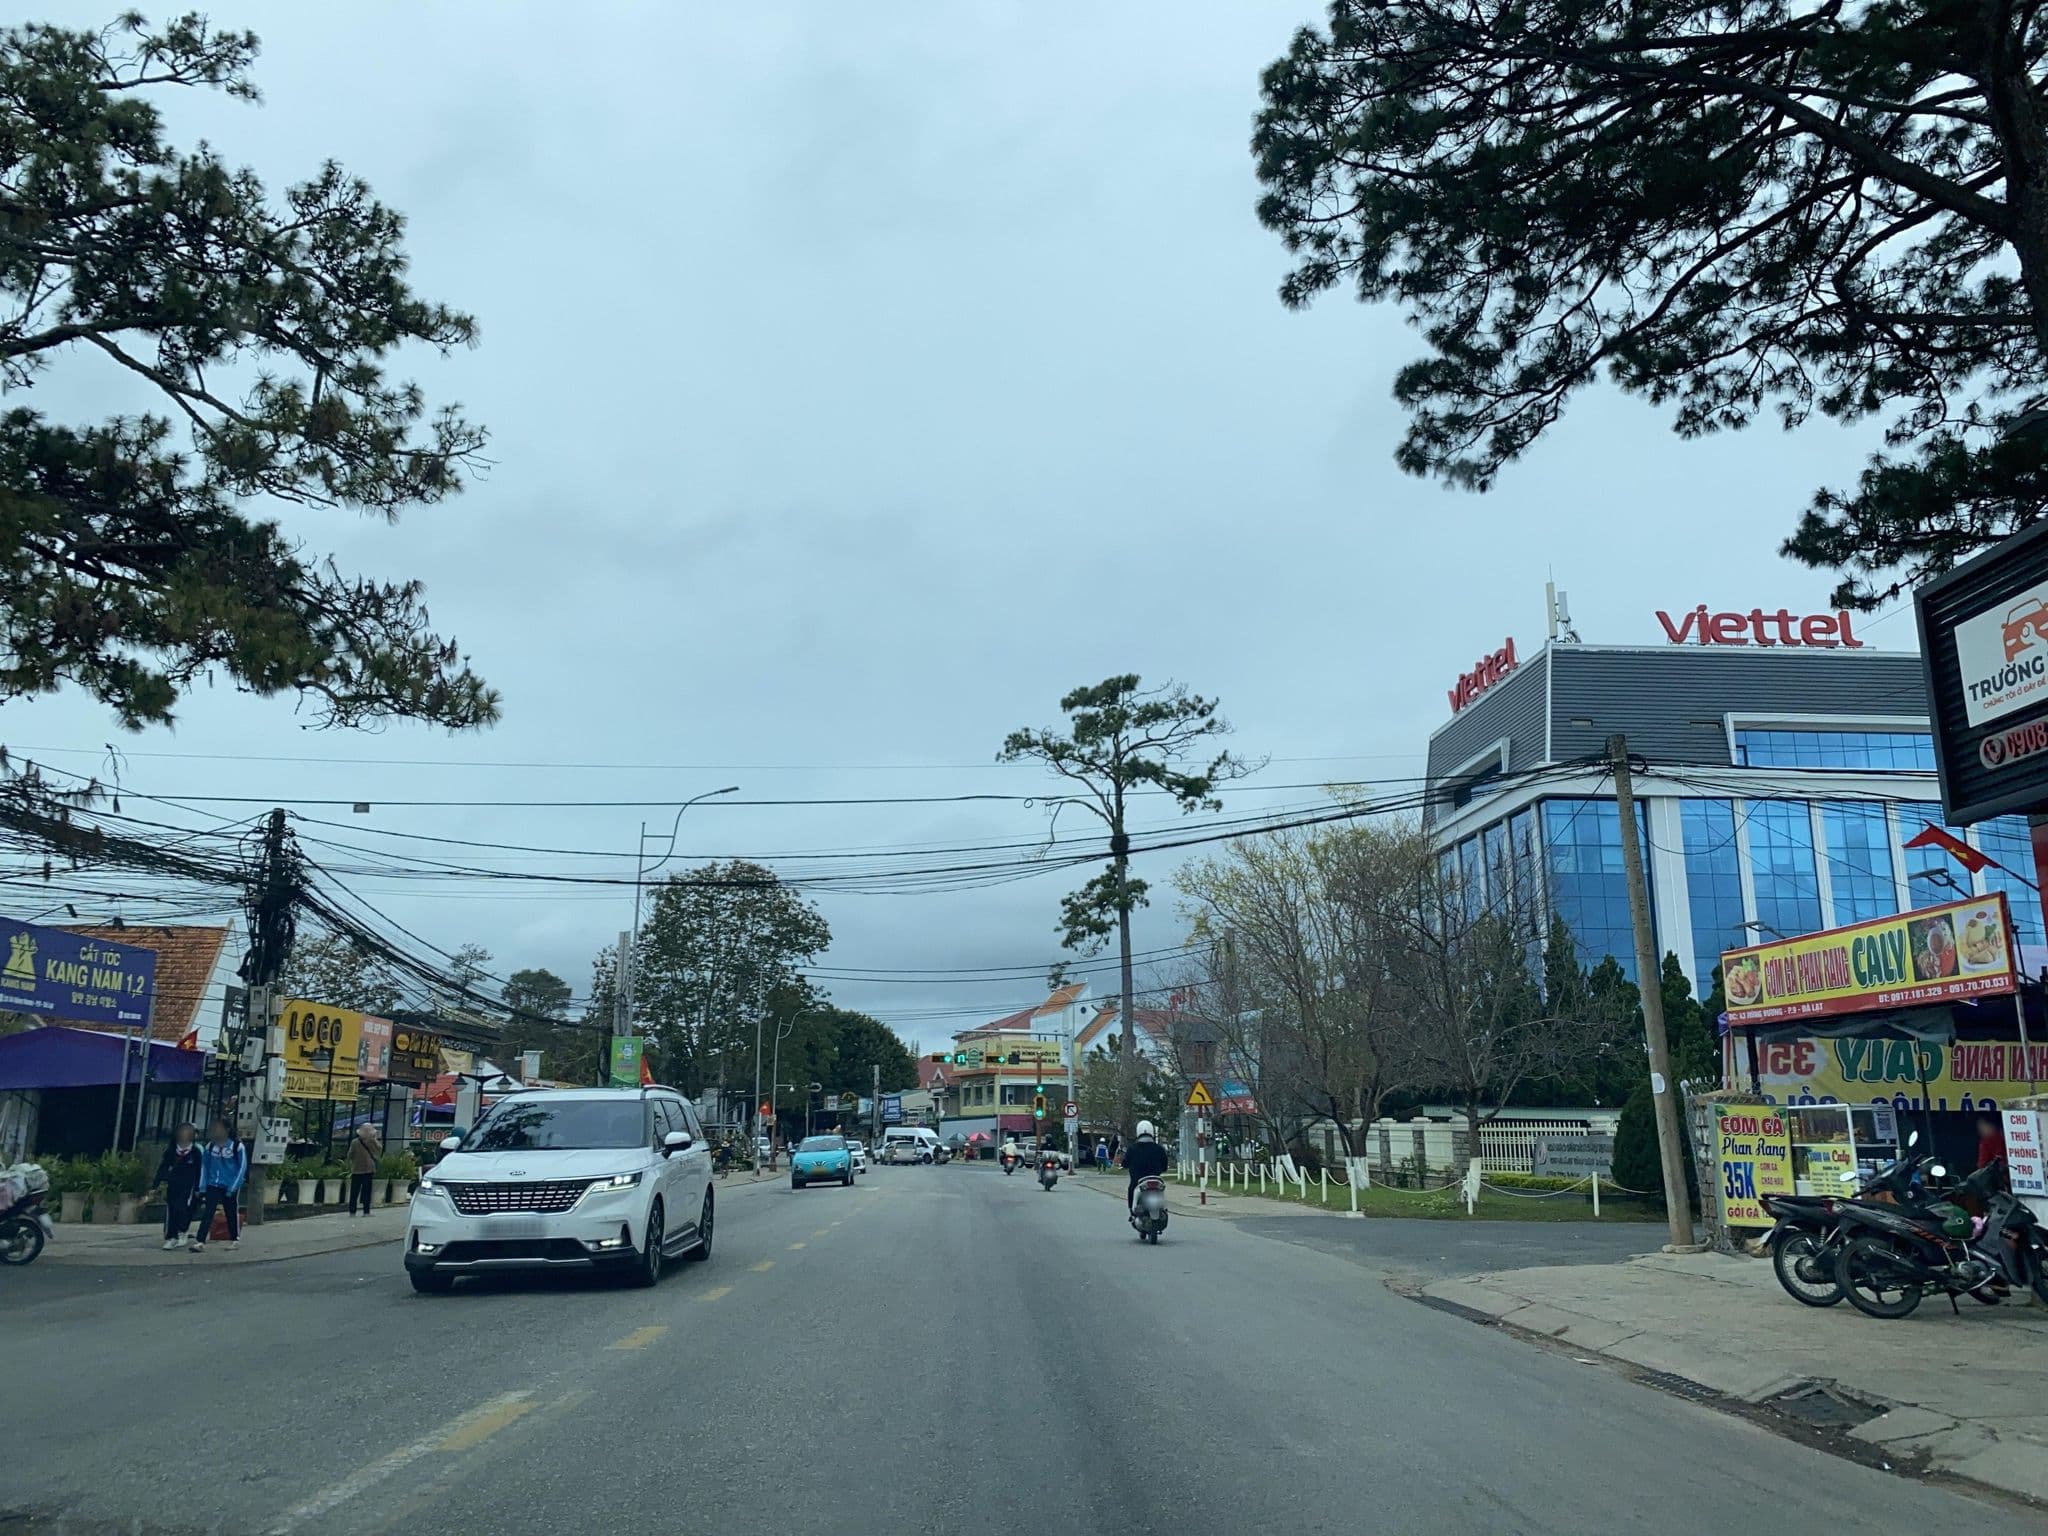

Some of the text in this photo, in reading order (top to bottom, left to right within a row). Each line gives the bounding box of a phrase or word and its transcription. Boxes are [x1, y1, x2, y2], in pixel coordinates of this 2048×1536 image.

[1656, 604, 1864, 648] viettel
[1447, 637, 1517, 713] viettel
[1969, 656, 2045, 701] TRƯỜNG
[80, 942, 99, 962] CẮT
[1852, 928, 1906, 988] CALY
[46, 959, 88, 987] KANG
[91, 967, 123, 991] NAM
[1764, 946, 1851, 998] CƠM GÀ PHAN RANG
[1720, 1112, 1784, 1136] CƠM GÀ
[2010, 1115, 2027, 1125] CHO
[2010, 1130, 2032, 1142] THUÊ
[1722, 1137, 1786, 1161] Phan Rang
[1723, 1161, 1756, 1199] 35K
